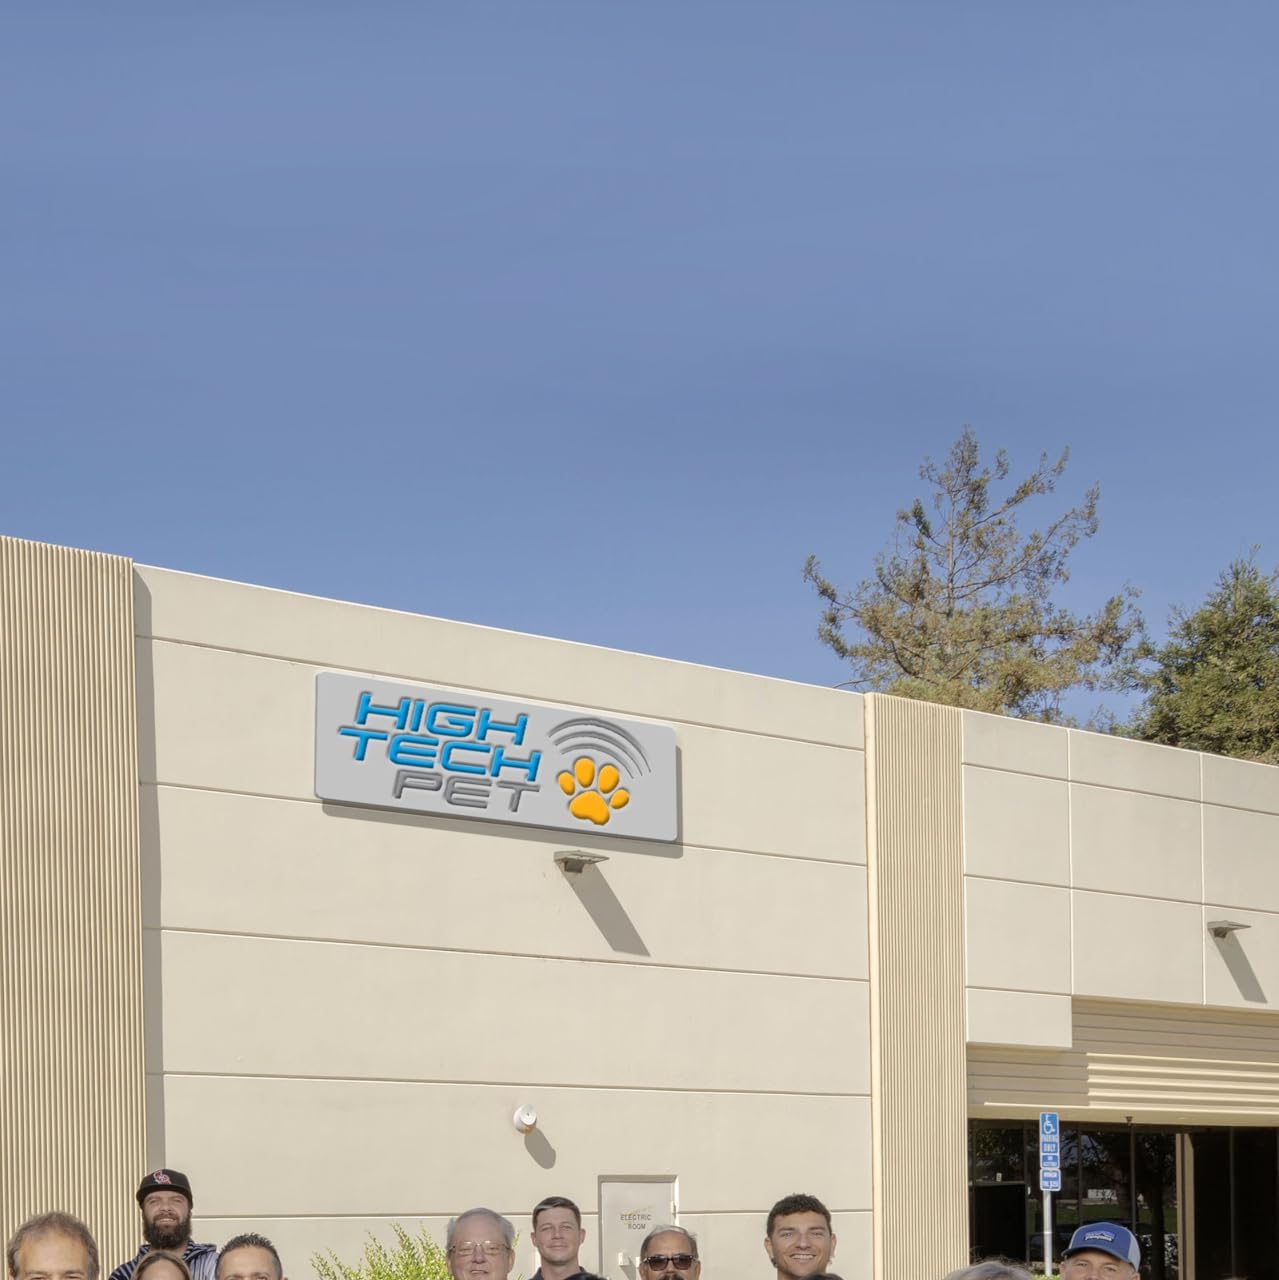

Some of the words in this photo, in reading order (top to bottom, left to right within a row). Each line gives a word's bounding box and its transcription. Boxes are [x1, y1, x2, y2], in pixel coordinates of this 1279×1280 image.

[355, 691, 529, 746] HIGH
[338, 726, 542, 782] TECH
[392, 769, 541, 813] PET
